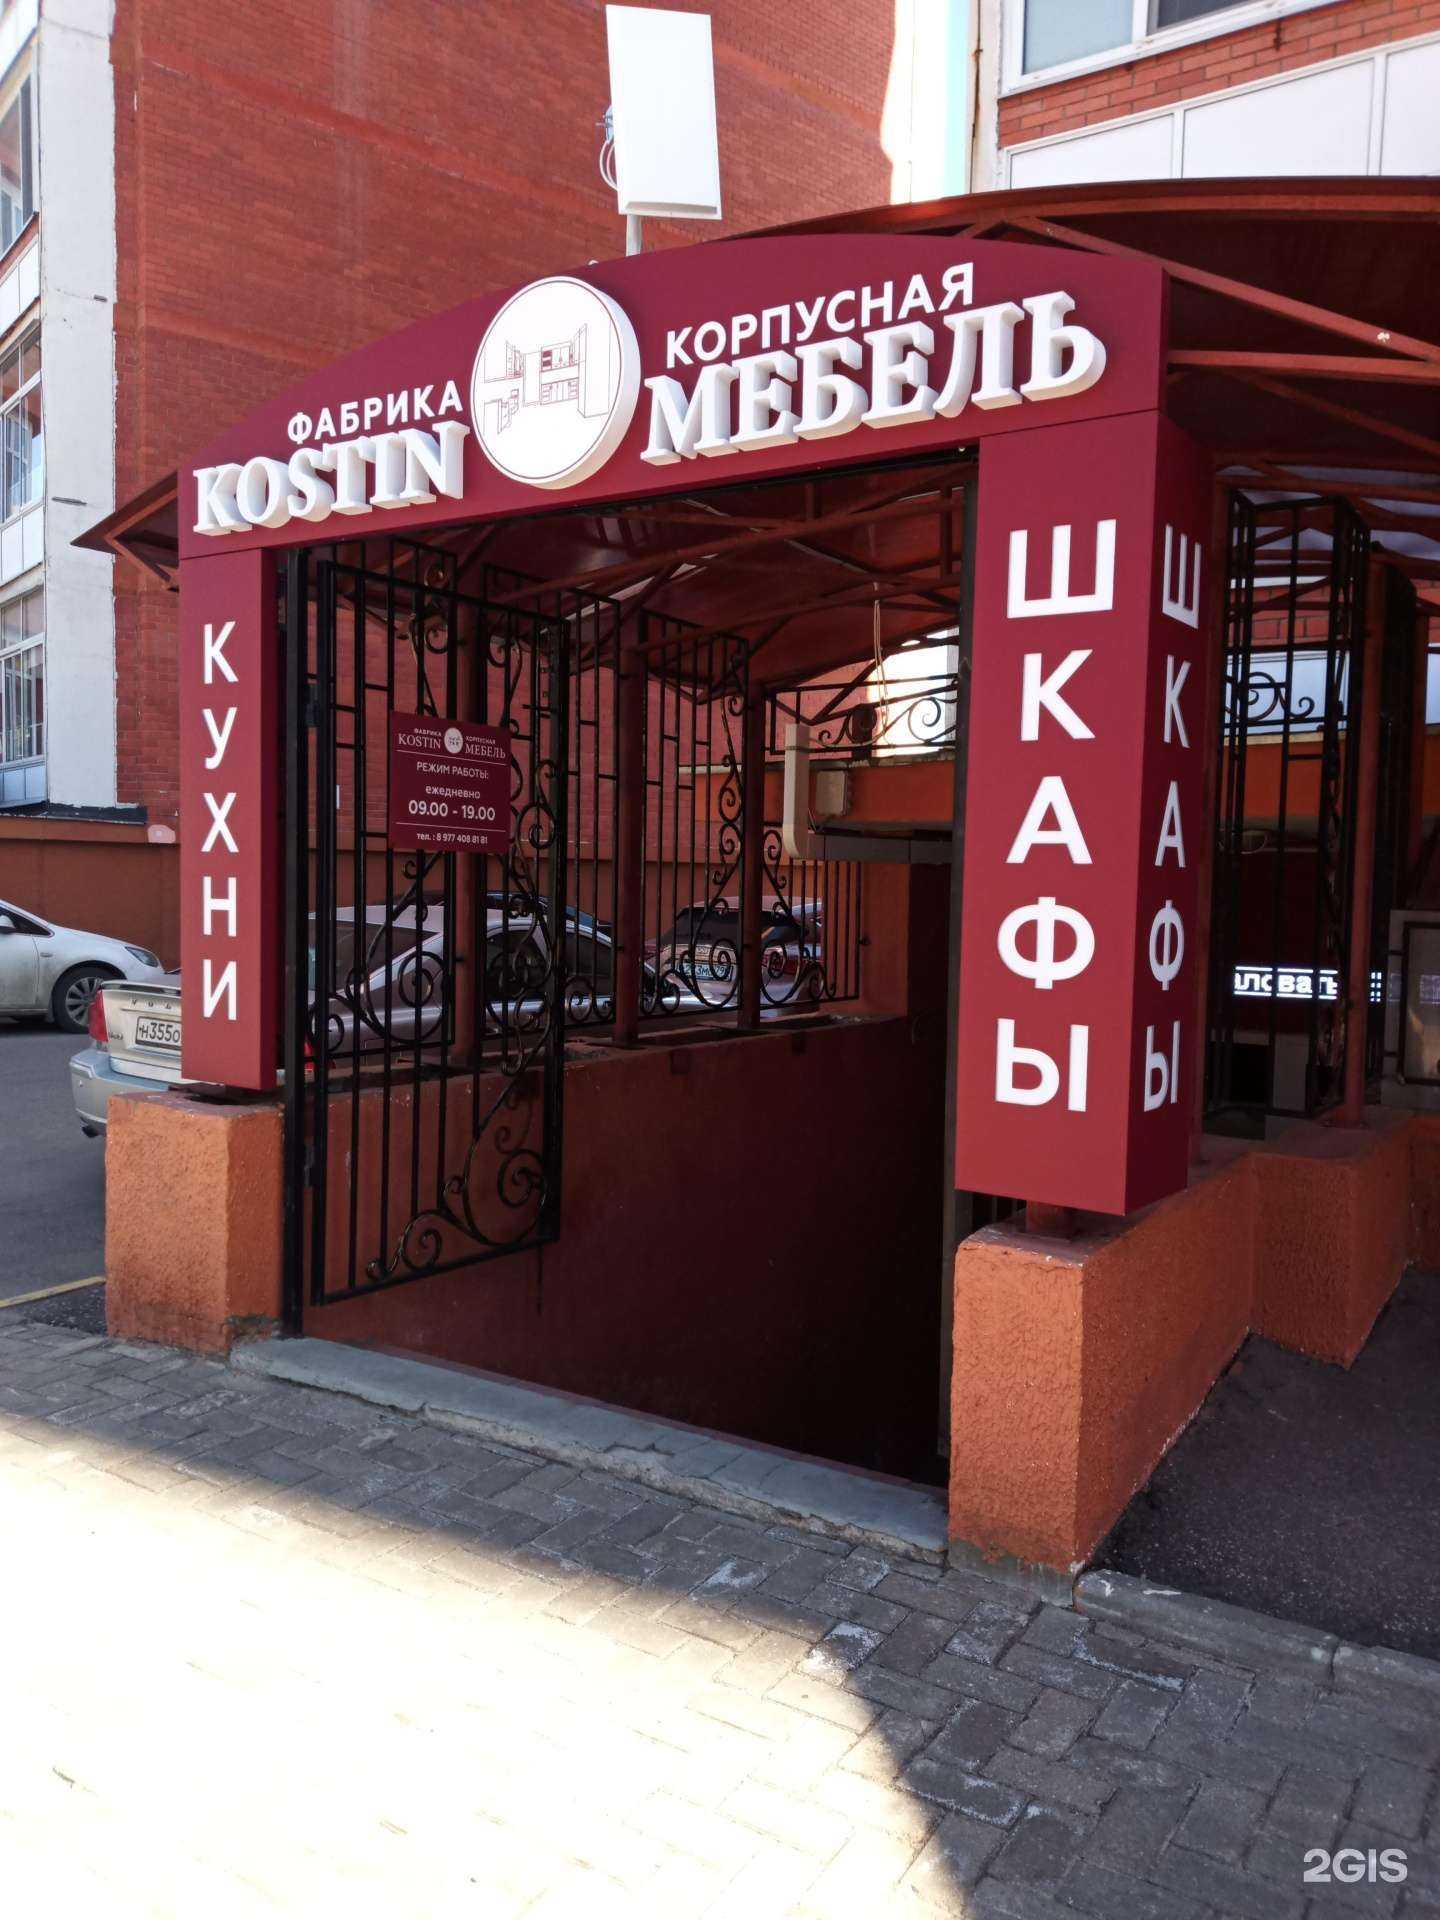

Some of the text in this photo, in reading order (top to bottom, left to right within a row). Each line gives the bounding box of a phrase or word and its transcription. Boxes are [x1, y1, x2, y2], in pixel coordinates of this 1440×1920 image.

[666, 262, 975, 368] КОРПУСНАЯ
[287, 380, 463, 444] ФАБРИКА
[640, 291, 1107, 465] МЕБЕЛЬ
[192, 420, 470, 536] KOSTIN
[398, 733, 441, 749] KOSTIN
[416, 761, 489, 780] РЕЖИМ РАБОТЫ:
[465, 743, 506, 759] МЕБЕЛЬ
[201, 621, 239, 1021] КУХНИ
[408, 800, 448, 817] 09.00
[461, 805, 496, 821] 19.00
[425, 785, 481, 799] ежедневно
[995, 519, 1117, 1112] ШКАФЫ
[1143, 523, 1201, 1112] ШКАФЫ
